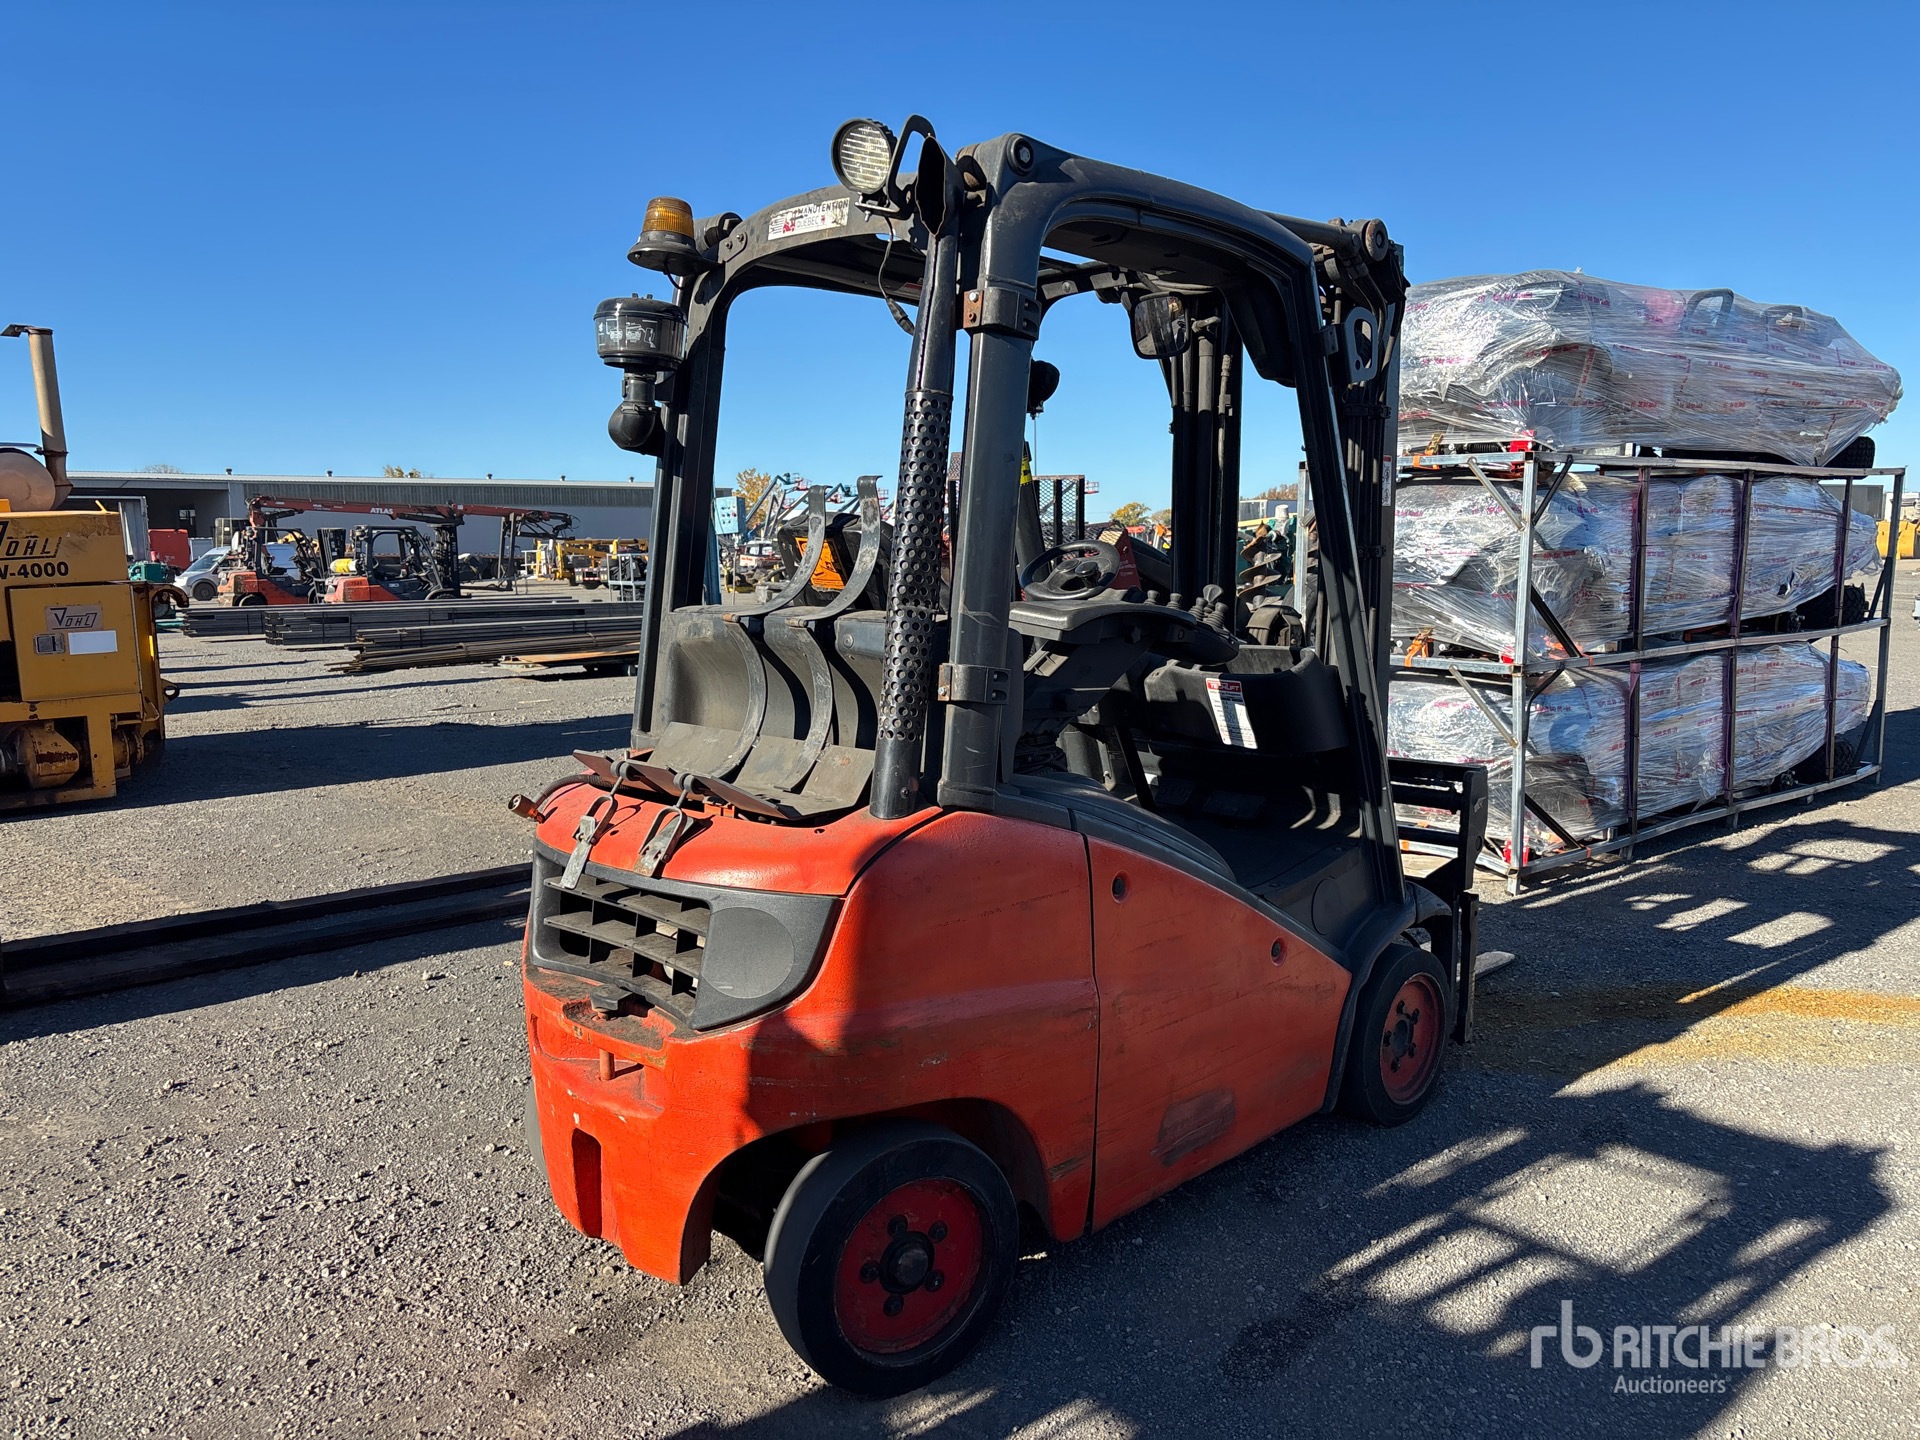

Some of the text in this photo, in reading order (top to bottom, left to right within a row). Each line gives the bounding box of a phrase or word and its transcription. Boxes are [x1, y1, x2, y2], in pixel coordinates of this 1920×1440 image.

[797, 199, 849, 214] MANUTENTION
[369, 507, 394, 515] ATLAS
[49, 607, 95, 628] VOHL
